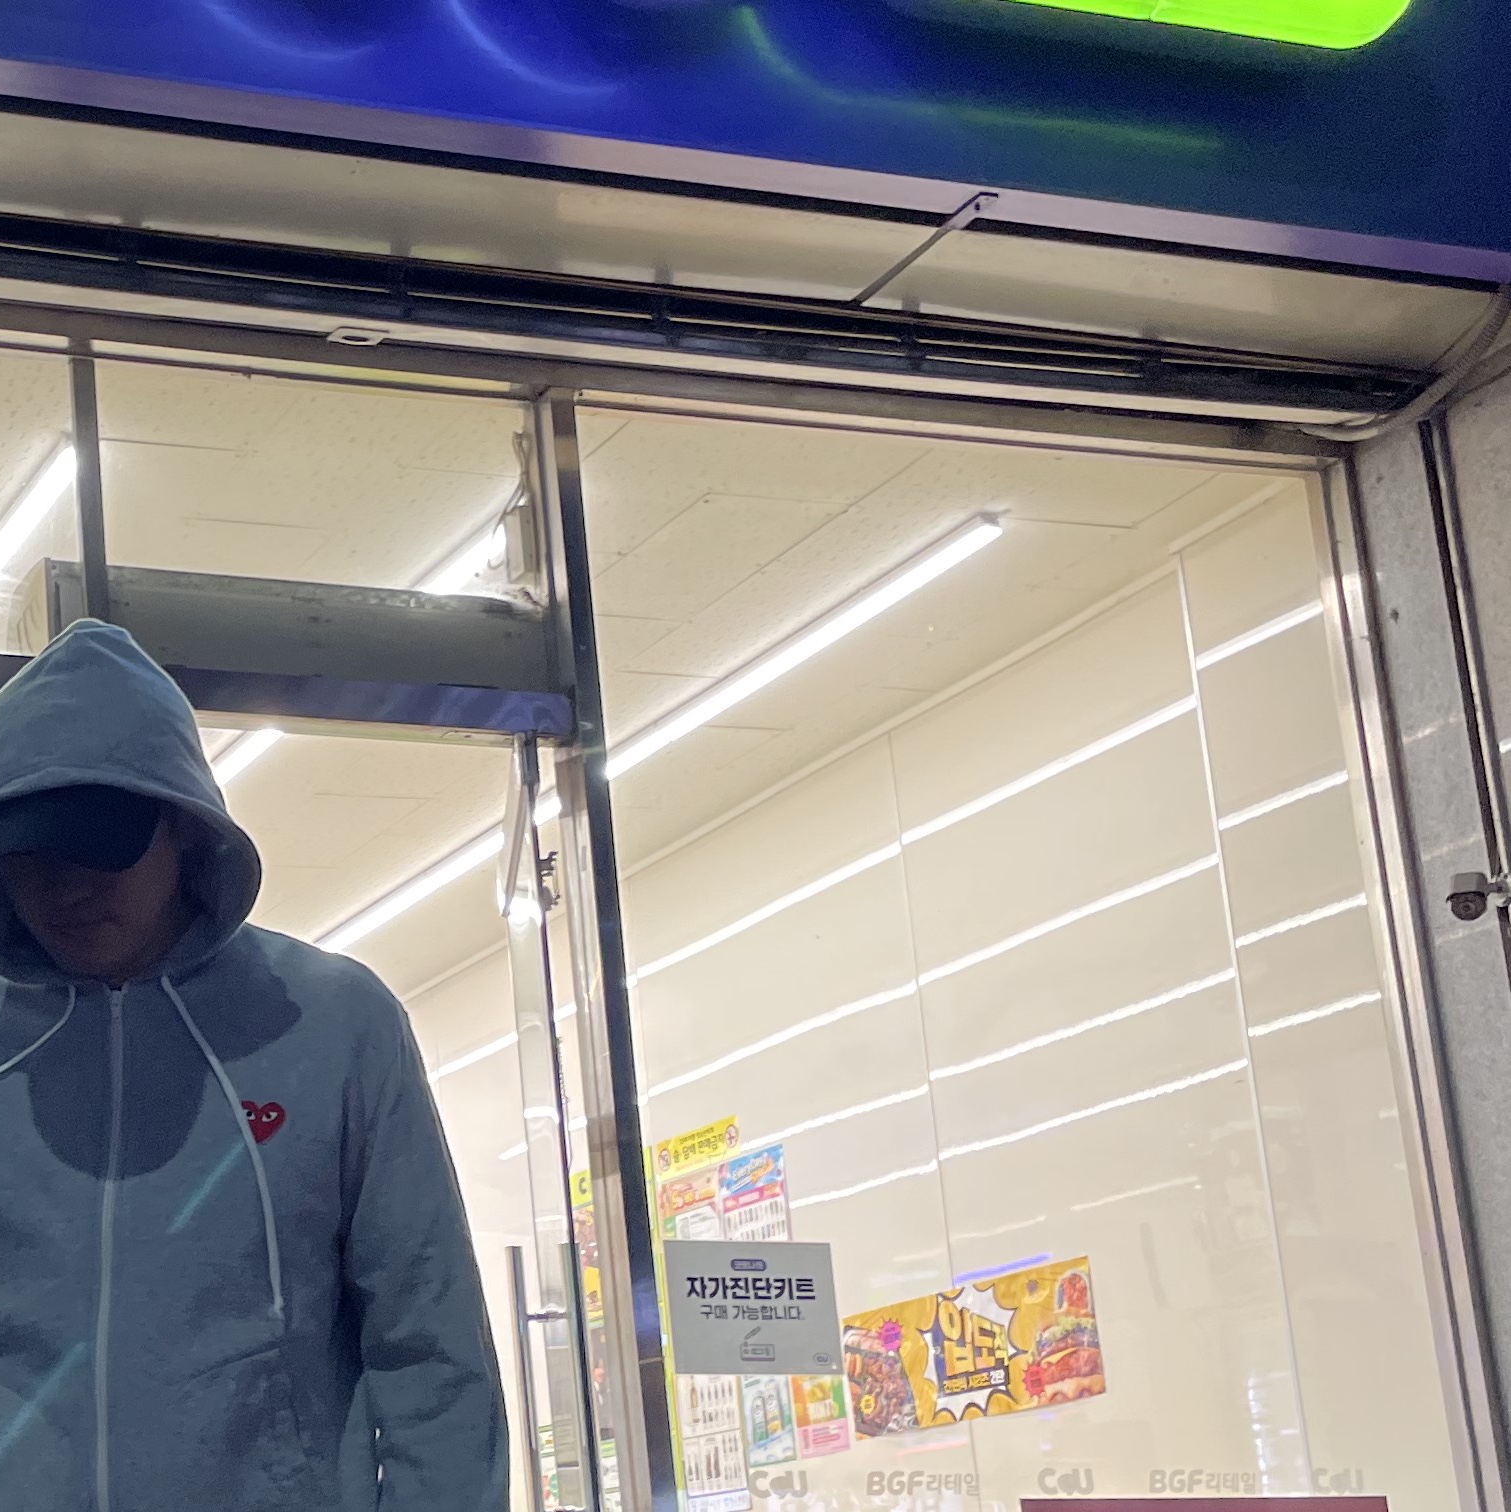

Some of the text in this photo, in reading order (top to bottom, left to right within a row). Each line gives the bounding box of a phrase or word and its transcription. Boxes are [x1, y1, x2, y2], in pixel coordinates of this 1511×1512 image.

[686, 1276, 816, 1301] 자가진단키트
[699, 1304, 806, 1321] 구매 가능합니다.
[749, 1470, 808, 1499] CU
[1037, 1467, 1095, 1495] CU
